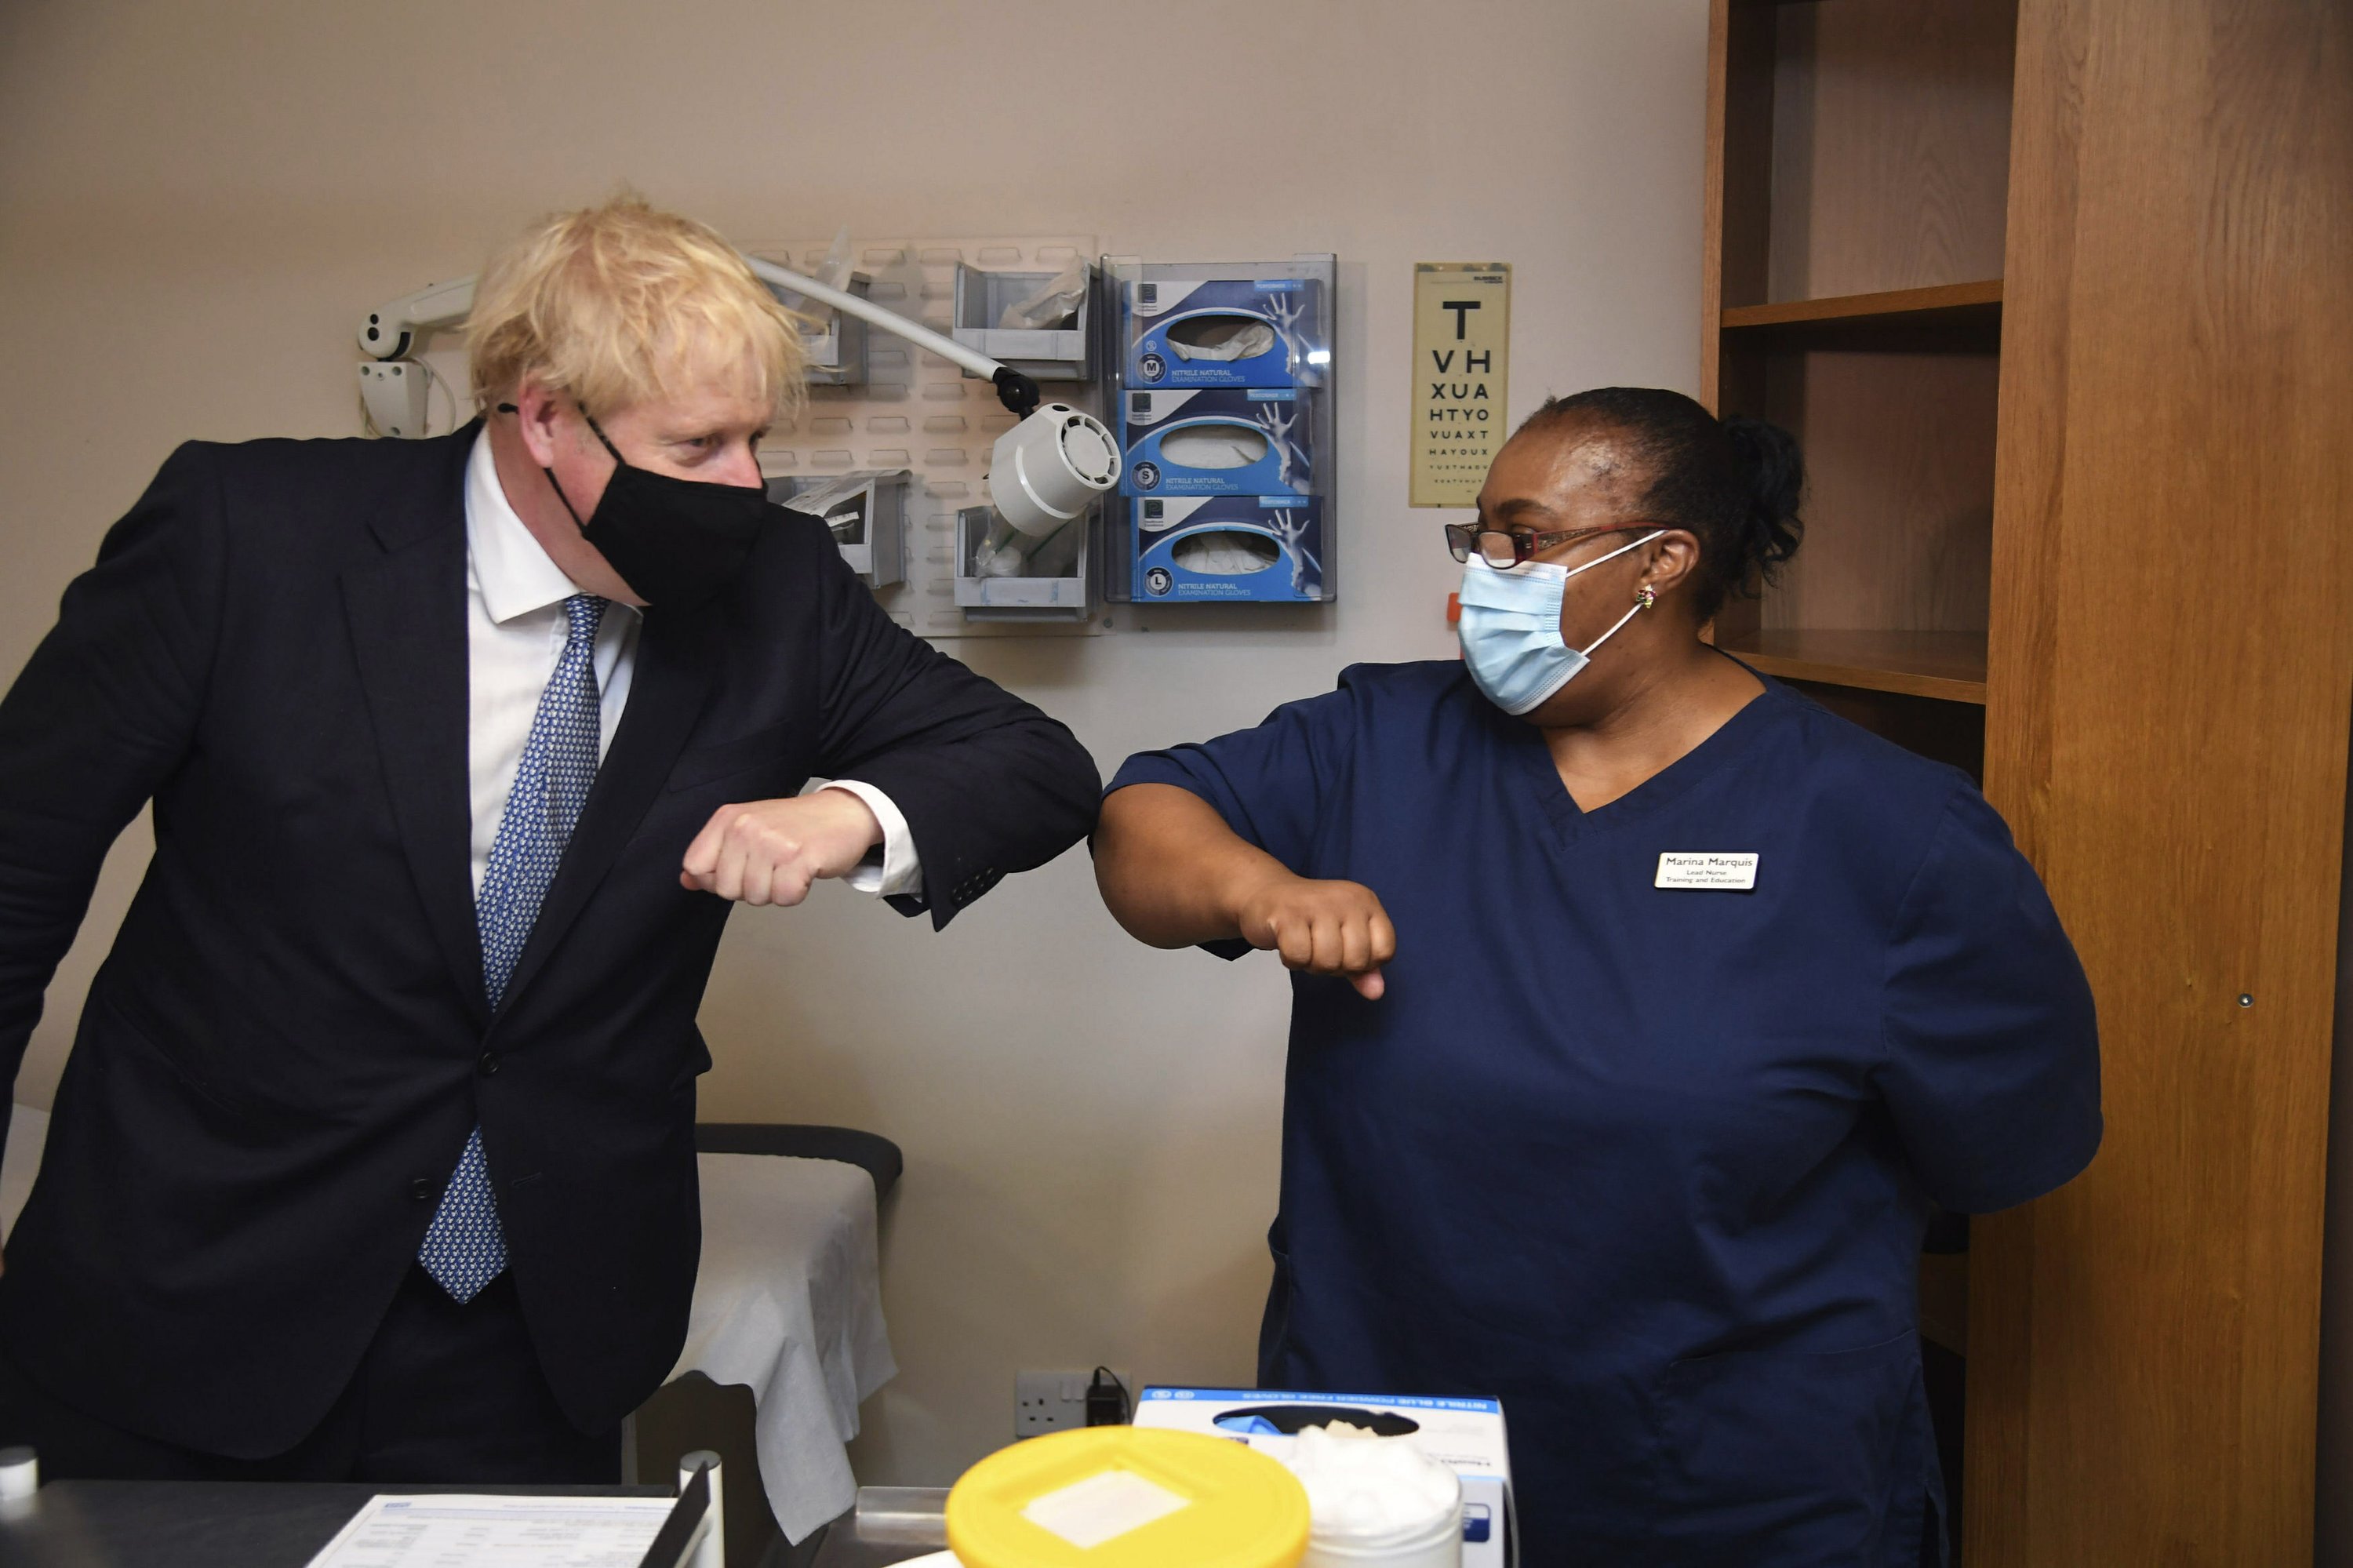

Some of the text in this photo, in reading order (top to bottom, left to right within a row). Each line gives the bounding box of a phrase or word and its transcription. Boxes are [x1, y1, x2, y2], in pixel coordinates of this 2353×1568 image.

[1442, 300, 1481, 340] T
[1146, 362, 1157, 371] M
[1431, 383, 1489, 399] XUA
[1430, 409, 1489, 421] HTYO
[1430, 431, 1489, 439] VUAXT
[1142, 471, 1150, 479] S
[1155, 577, 1162, 585] L
[1666, 857, 1753, 868] Marina Marquis
